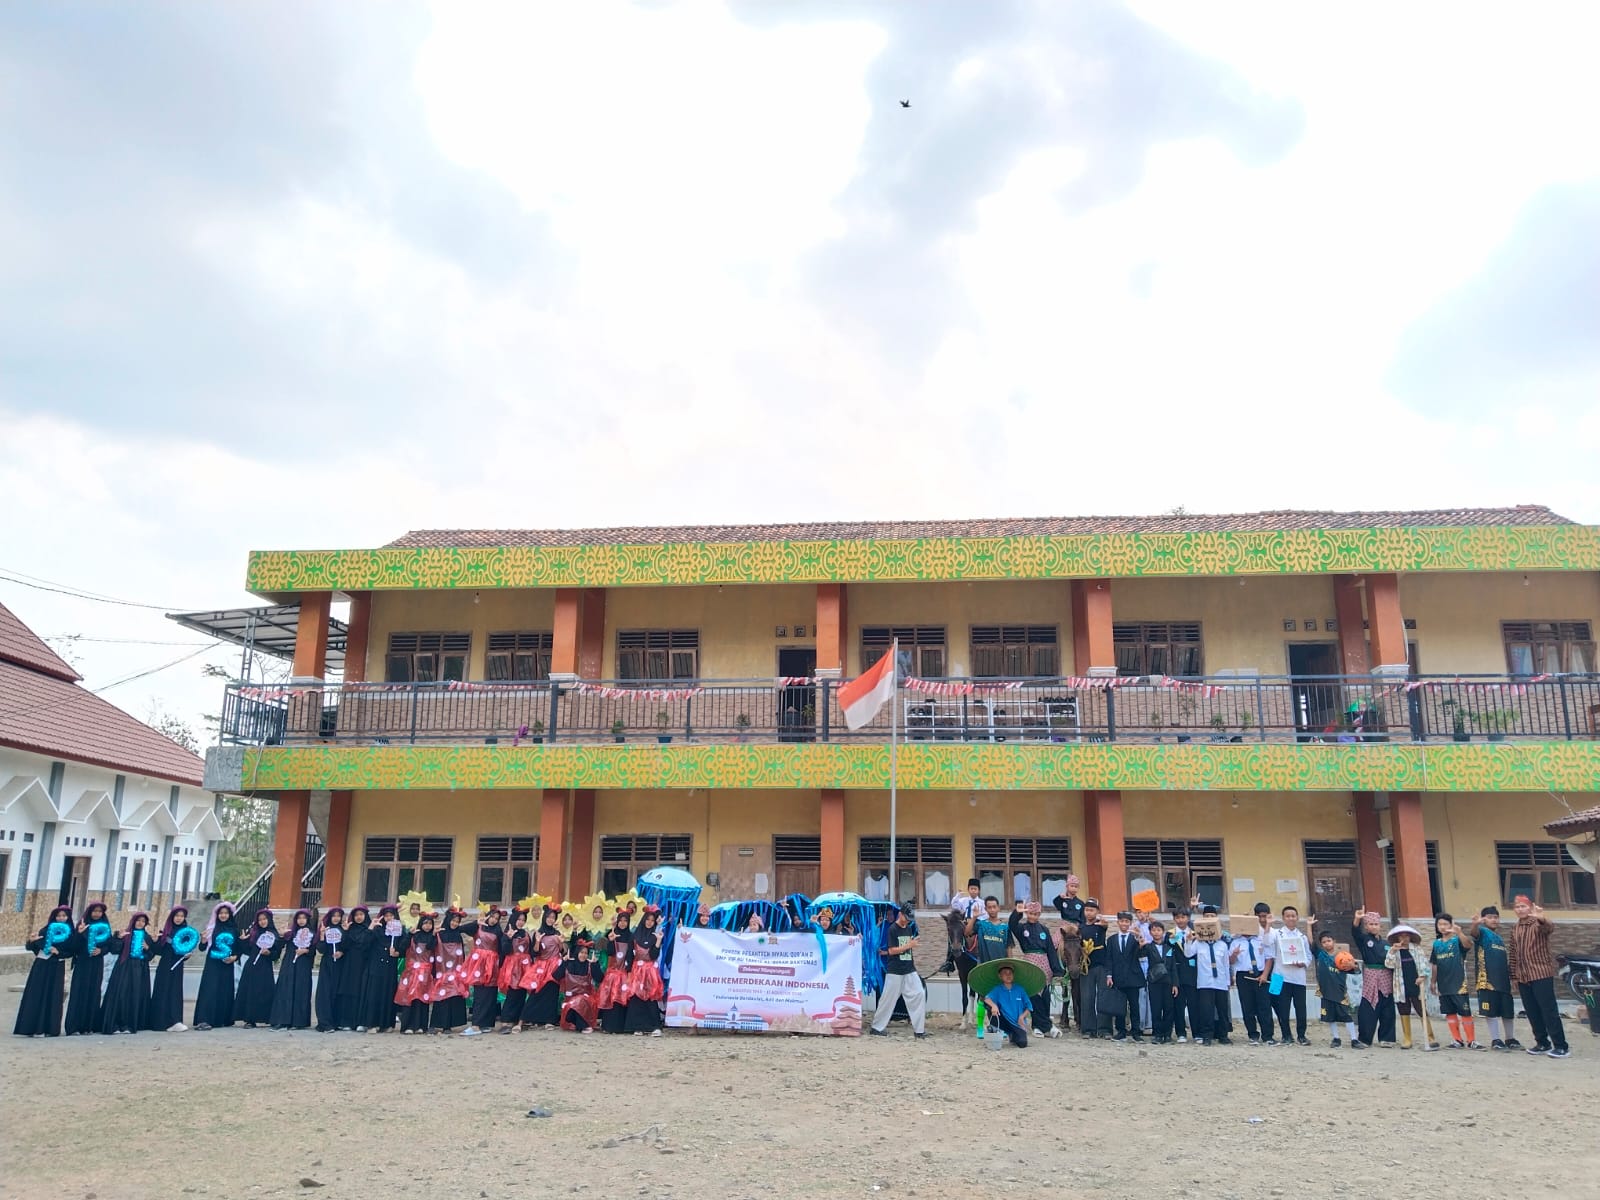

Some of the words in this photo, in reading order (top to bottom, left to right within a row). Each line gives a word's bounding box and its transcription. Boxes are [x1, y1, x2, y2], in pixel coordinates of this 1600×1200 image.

[700, 976, 721, 984] HARI
[721, 976, 783, 987] KEMERDEKAAN
[785, 981, 830, 990] INDONESIA
